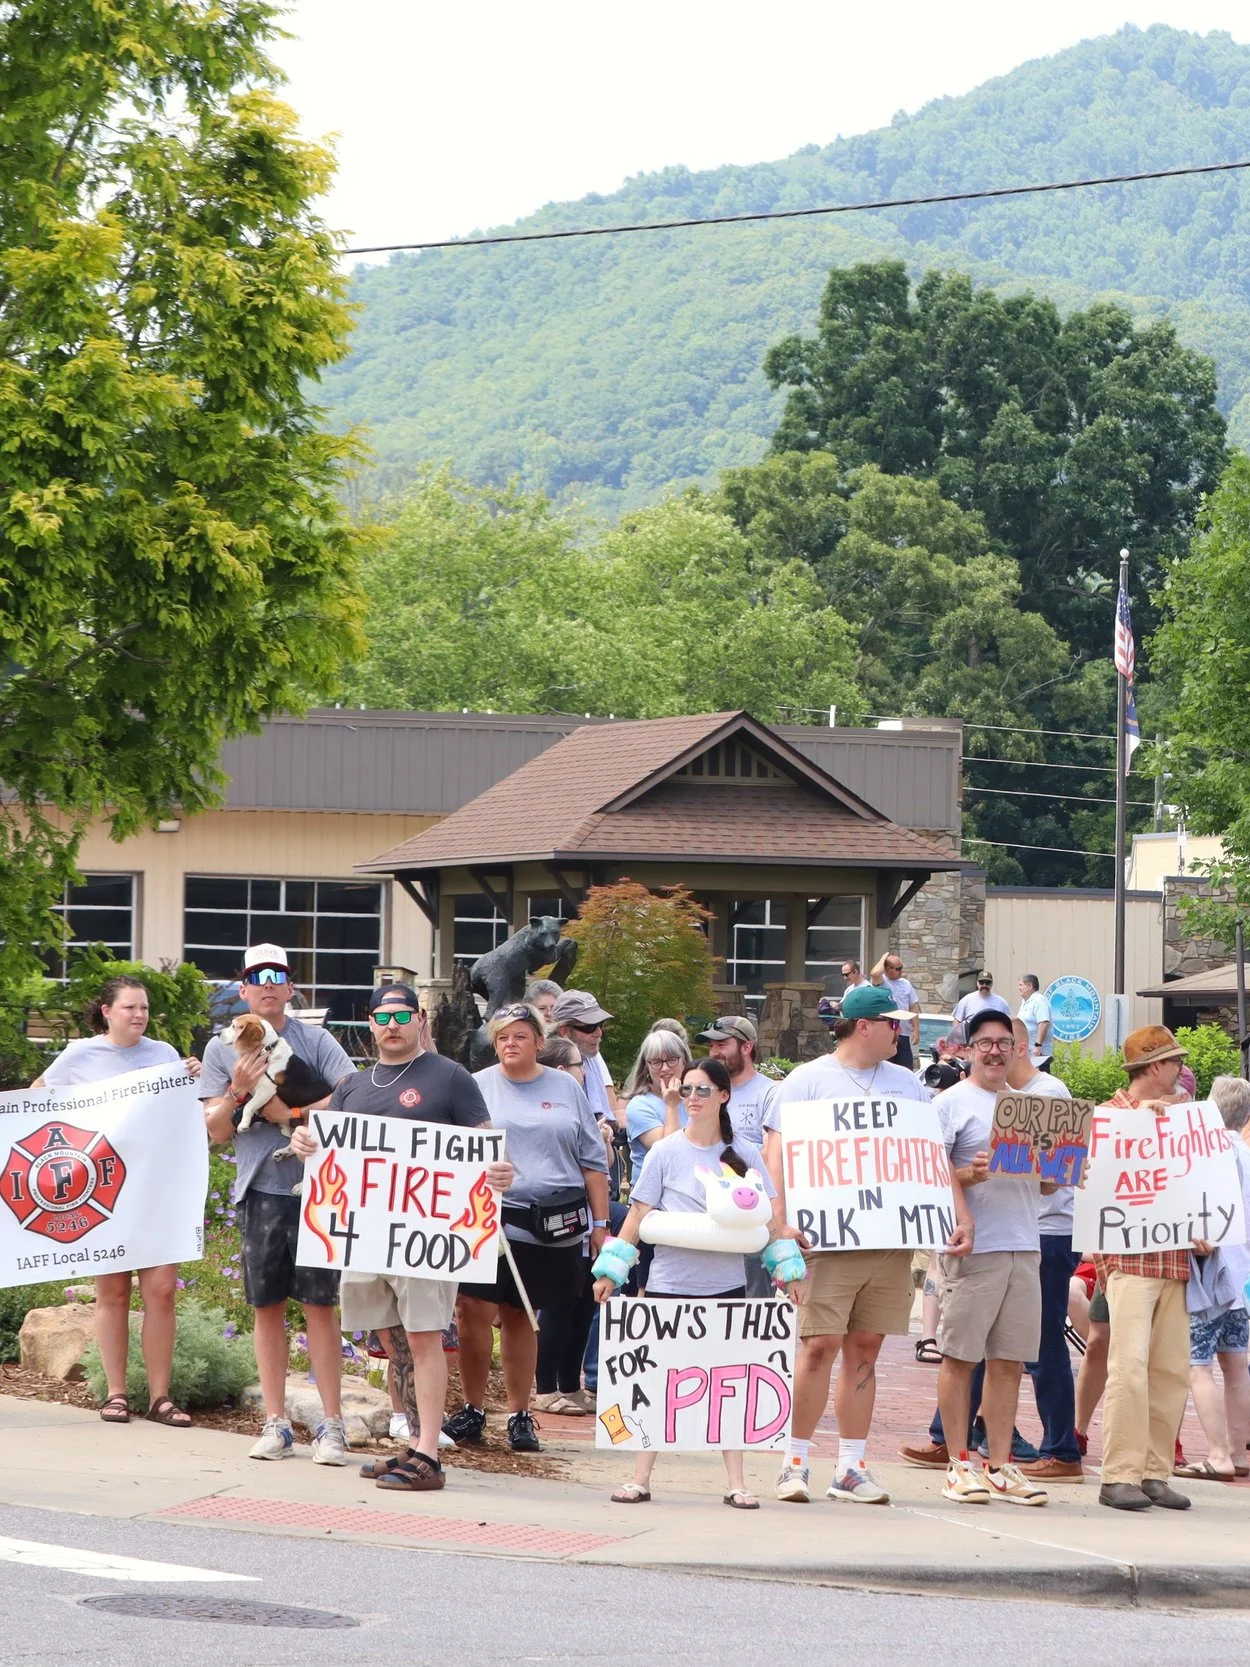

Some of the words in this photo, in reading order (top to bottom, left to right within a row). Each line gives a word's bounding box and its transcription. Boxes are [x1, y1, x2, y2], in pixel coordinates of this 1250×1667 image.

[1085, 984, 1100, 1030] MOUNTAIN
[23, 1091, 108, 1113] Professional
[112, 1074, 195, 1100] FireFighters
[833, 1101, 898, 1131] KEEP
[996, 1096, 1045, 1136] OUR
[1047, 1099, 1091, 1134] PAY
[44, 1127, 71, 1149] A
[313, 1113, 396, 1153] WILL
[411, 1127, 503, 1162] FIGHT
[989, 1141, 1033, 1174] ALL
[35, 1152, 52, 1168] BLACK
[54, 1150, 87, 1163] MOUNTAIN
[99, 1157, 116, 1186] F
[786, 1136, 952, 1189] FIREFIGHTERS
[1039, 1145, 1089, 1186] WET
[10, 1172, 23, 1200] I
[50, 1160, 73, 1200] F
[360, 1157, 455, 1220] FIRE
[858, 1186, 883, 1211] IN
[1114, 1168, 1169, 1194] ARE
[46, 1217, 88, 1233] 5246
[797, 1207, 860, 1248] BLK
[899, 1204, 955, 1246] MTN
[1098, 1191, 1236, 1251] Priority
[17, 1256, 49, 1271] IAFF
[53, 1249, 90, 1265] Local
[93, 1245, 126, 1262] 5246
[329, 1210, 360, 1267] 4
[386, 1222, 471, 1273] FOOD
[605, 1301, 707, 1343] HOW'S
[717, 1302, 794, 1340] THIS
[605, 1344, 658, 1385] FOR
[631, 1383, 651, 1411] A
[665, 1363, 791, 1444] PFD
